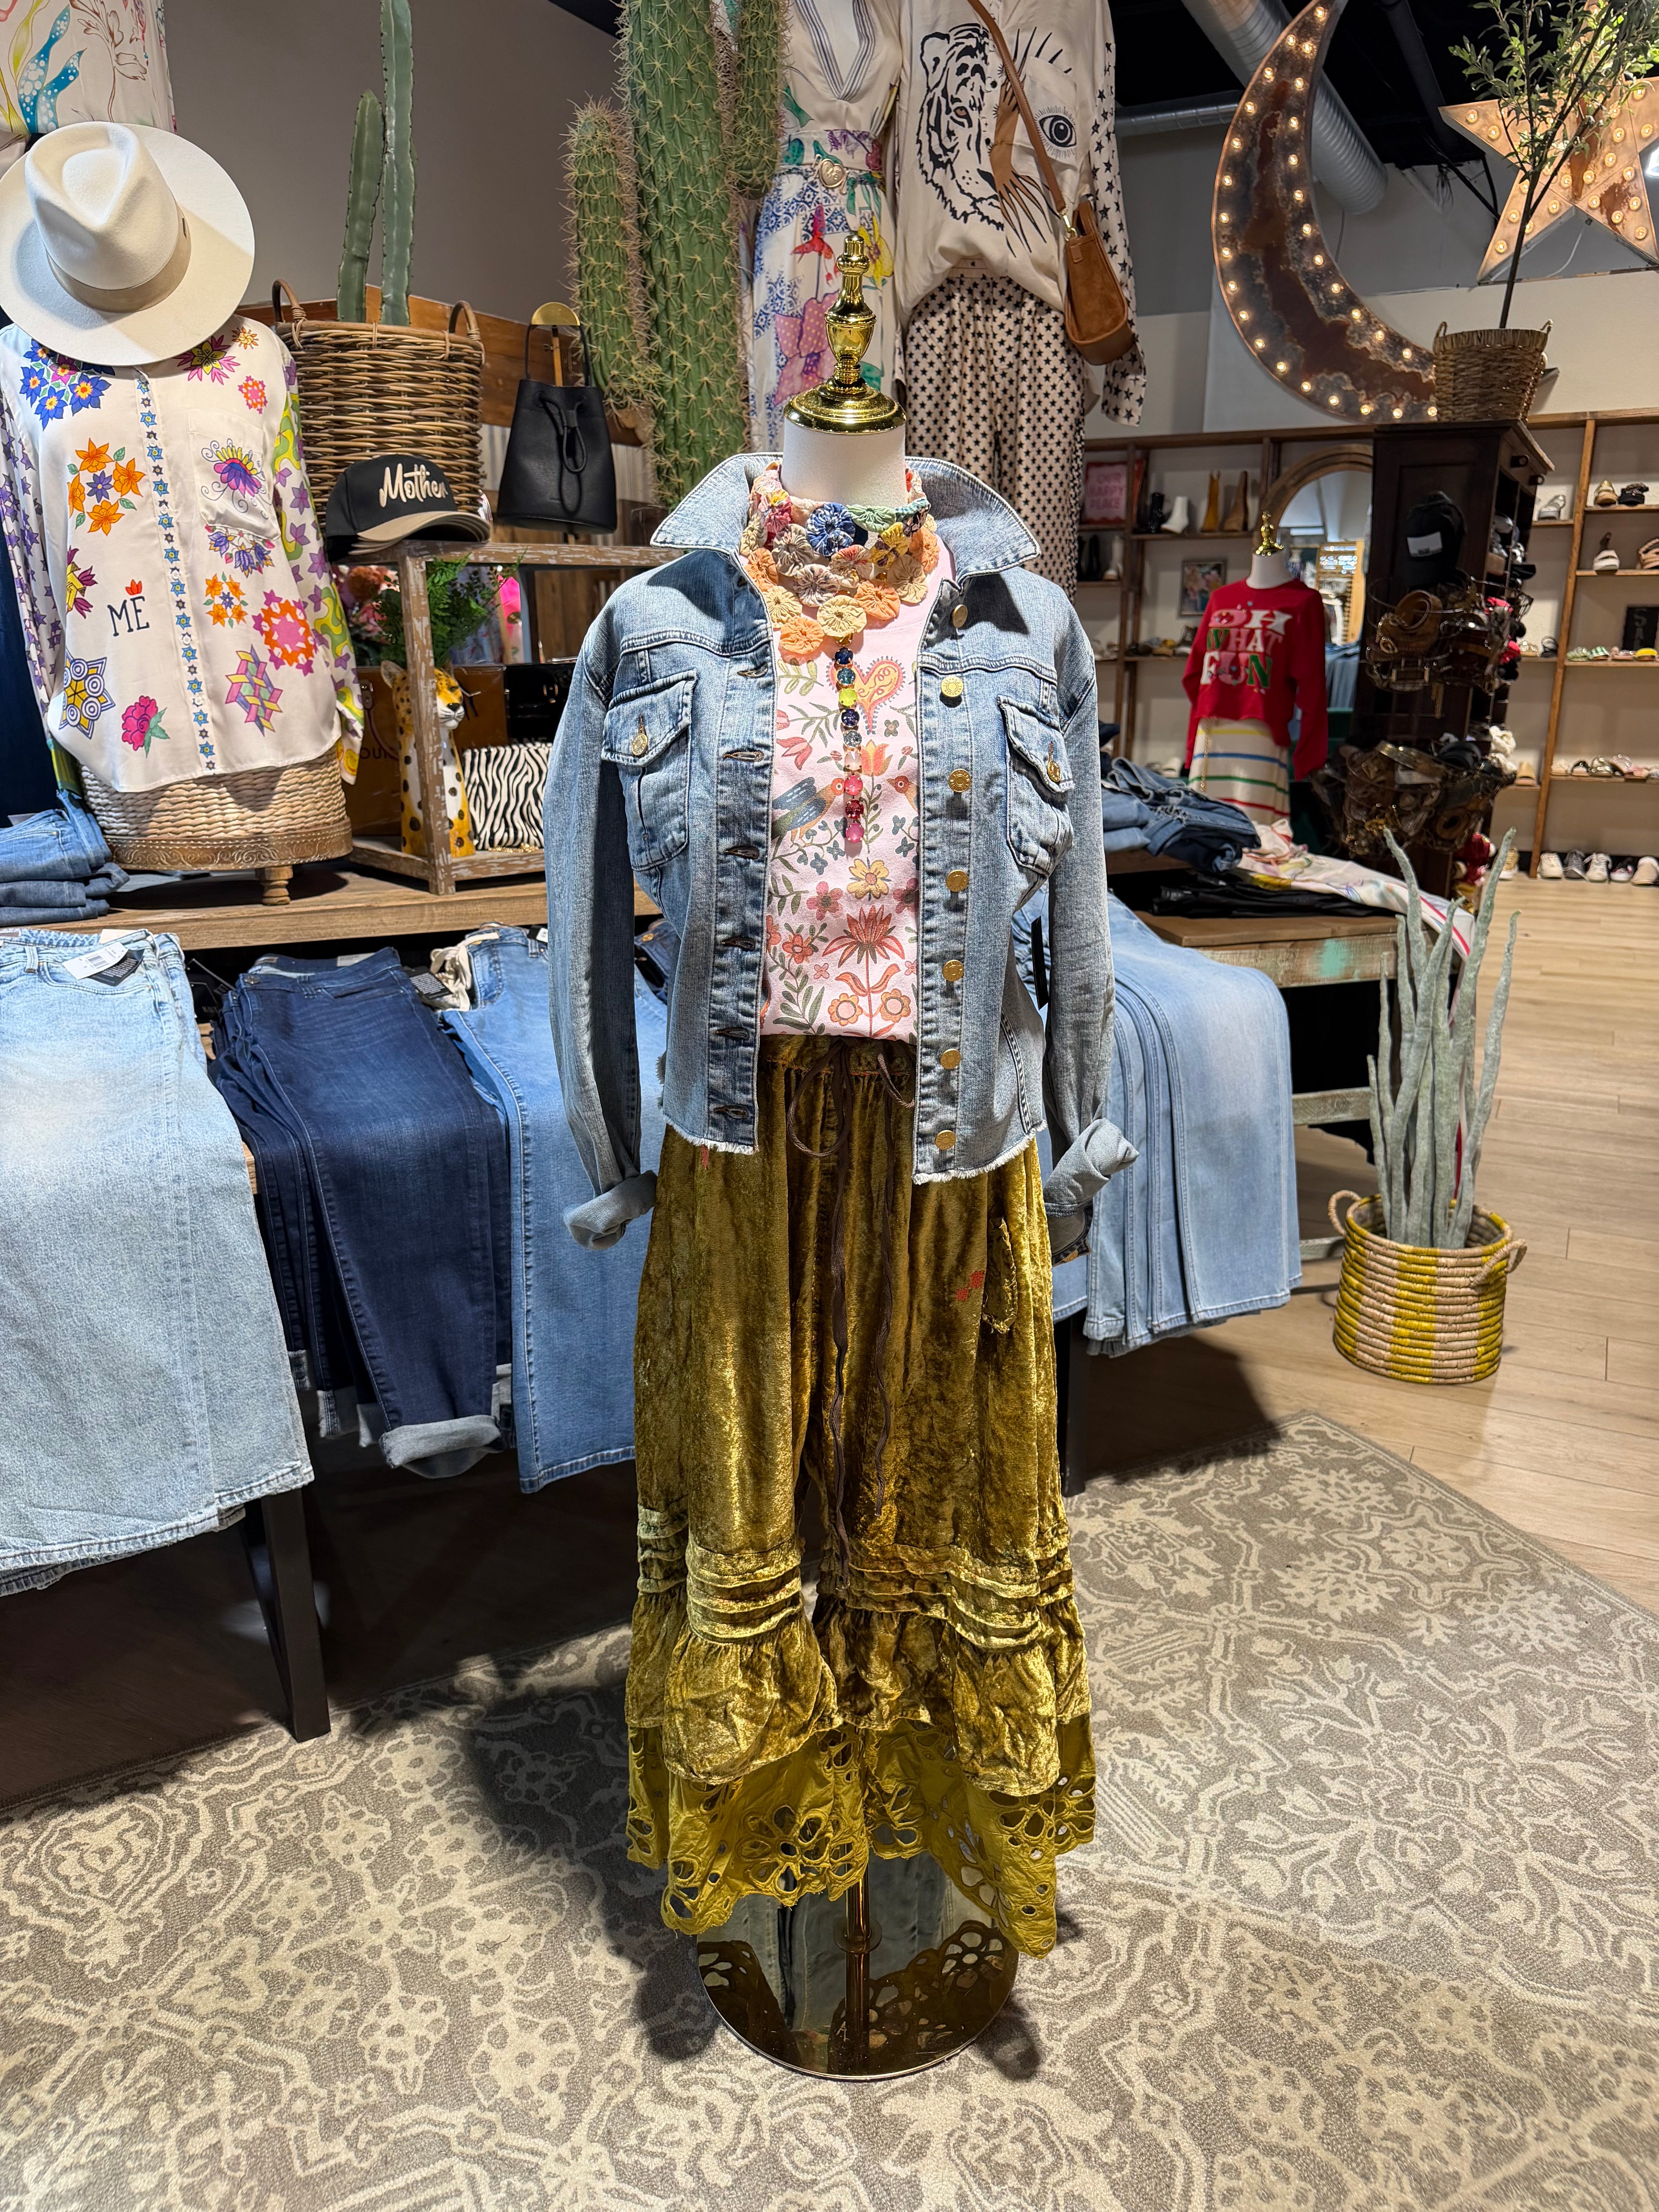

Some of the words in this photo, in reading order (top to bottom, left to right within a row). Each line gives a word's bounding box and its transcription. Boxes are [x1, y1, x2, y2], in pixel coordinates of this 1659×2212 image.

[379, 463, 448, 508] Mother
[107, 596, 150, 637] ME
[1208, 608, 1293, 635] OH
[1206, 628, 1283, 656] WHAT
[1200, 651, 1273, 689] FUN
